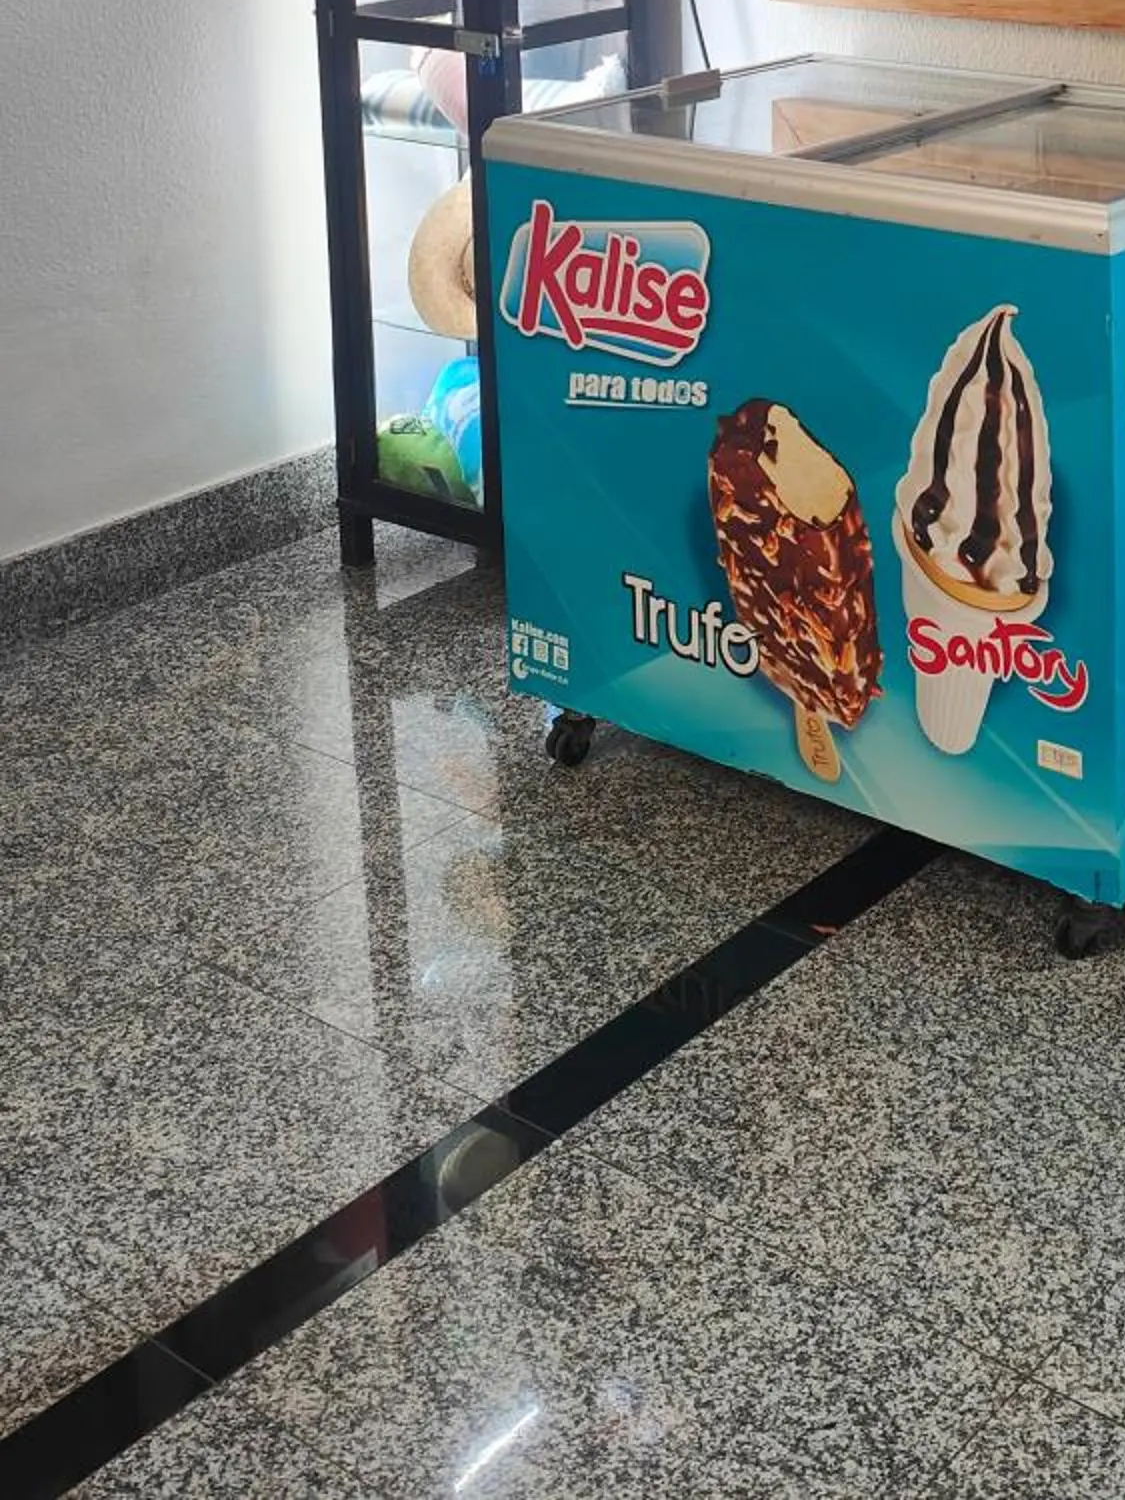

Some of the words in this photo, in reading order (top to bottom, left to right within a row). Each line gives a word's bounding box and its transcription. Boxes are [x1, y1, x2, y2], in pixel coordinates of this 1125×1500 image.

[519, 200, 709, 349] Kalise
[569, 371, 626, 401] para
[631, 376, 709, 407] todos
[622, 571, 763, 678] Trufo
[907, 616, 1089, 712] Santory
